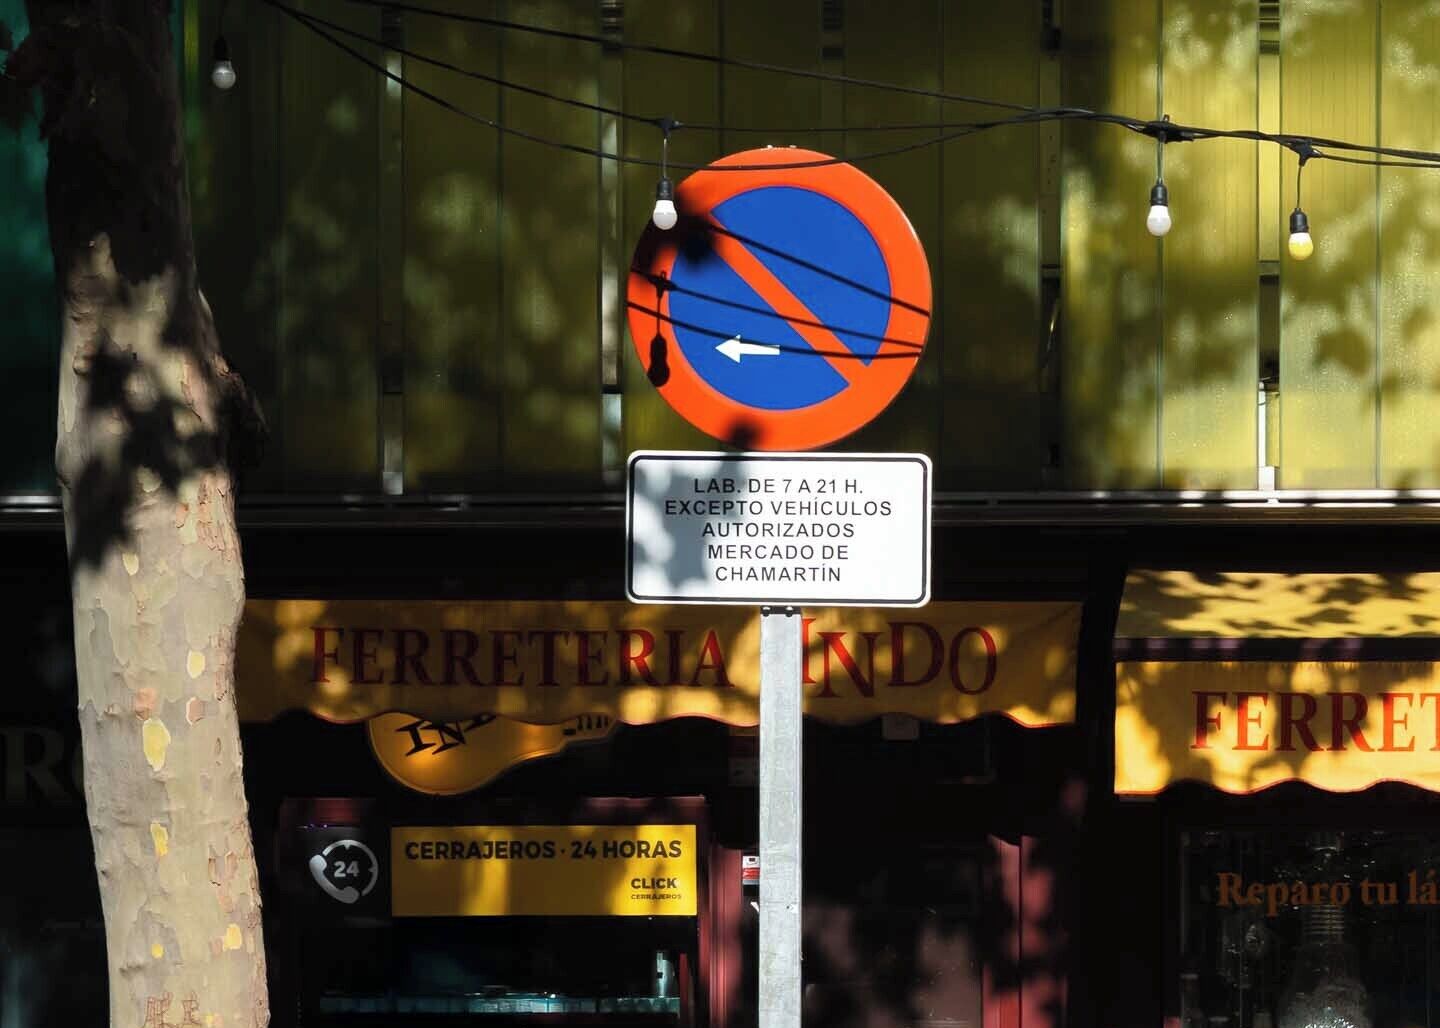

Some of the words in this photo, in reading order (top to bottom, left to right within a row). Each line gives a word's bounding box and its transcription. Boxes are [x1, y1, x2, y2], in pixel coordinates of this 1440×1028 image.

[693, 478, 742, 494] LAB.
[748, 478, 775, 493] DE
[782, 478, 793, 493] 7
[798, 478, 811, 493] A
[816, 478, 837, 493] 21
[844, 479, 864, 494] H.
[664, 499, 764, 516] EXCEPTO
[770, 497, 892, 517] VEHÍCULOS
[701, 522, 855, 538] AUTORIZADOS
[707, 544, 815, 560] MERCADO
[821, 544, 849, 560] DE
[715, 563, 841, 582] CHAMARTÍN
[309, 626, 735, 687] FERRETERIA
[404, 841, 556, 860] CERRAJEROS
[570, 841, 598, 860] 24
[602, 840, 683, 859] HORAS
[333, 861, 360, 878] 24
[630, 877, 677, 889] CLICK
[1215, 871, 1350, 918] Reparo
[1359, 876, 1399, 906] tu
